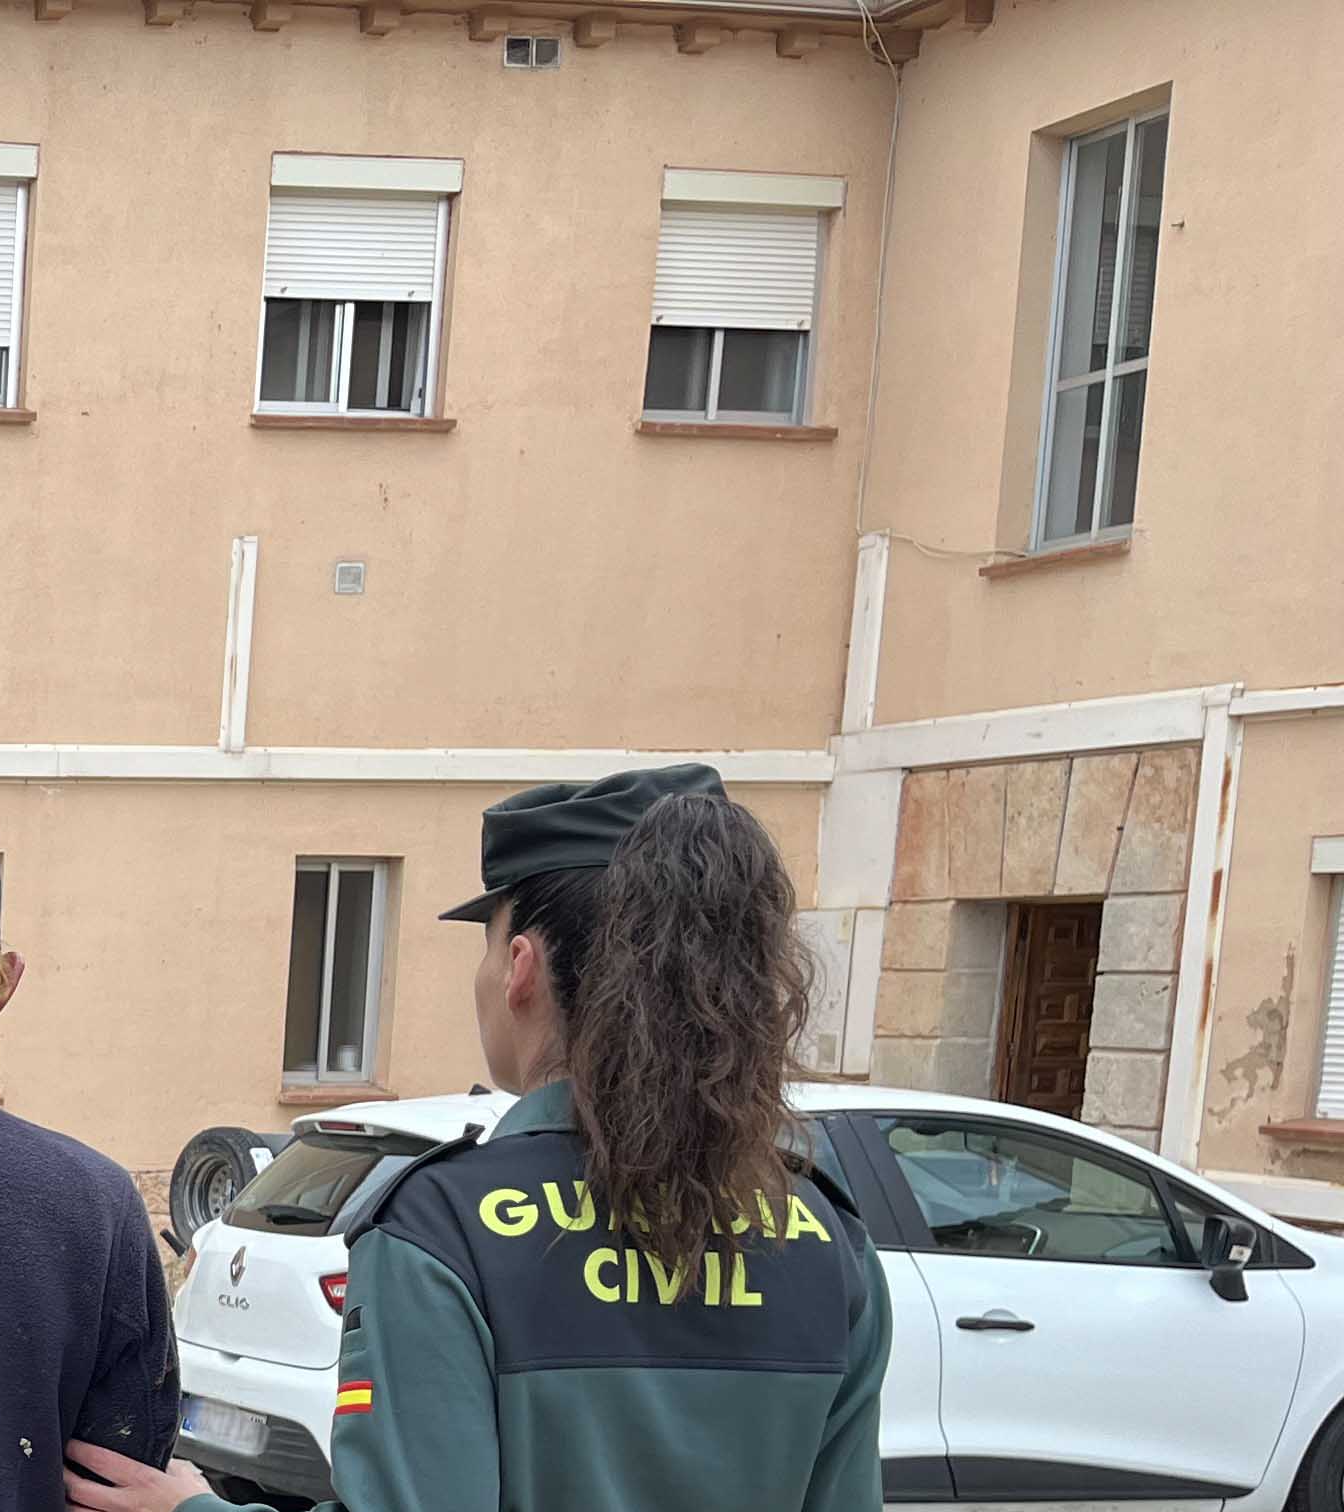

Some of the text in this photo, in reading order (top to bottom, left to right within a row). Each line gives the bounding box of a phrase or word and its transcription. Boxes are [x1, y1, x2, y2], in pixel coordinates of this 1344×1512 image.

[478, 1180, 832, 1243] GUIA
[218, 1294, 250, 1310] CLIO
[583, 1247, 763, 1307] CIVIL
